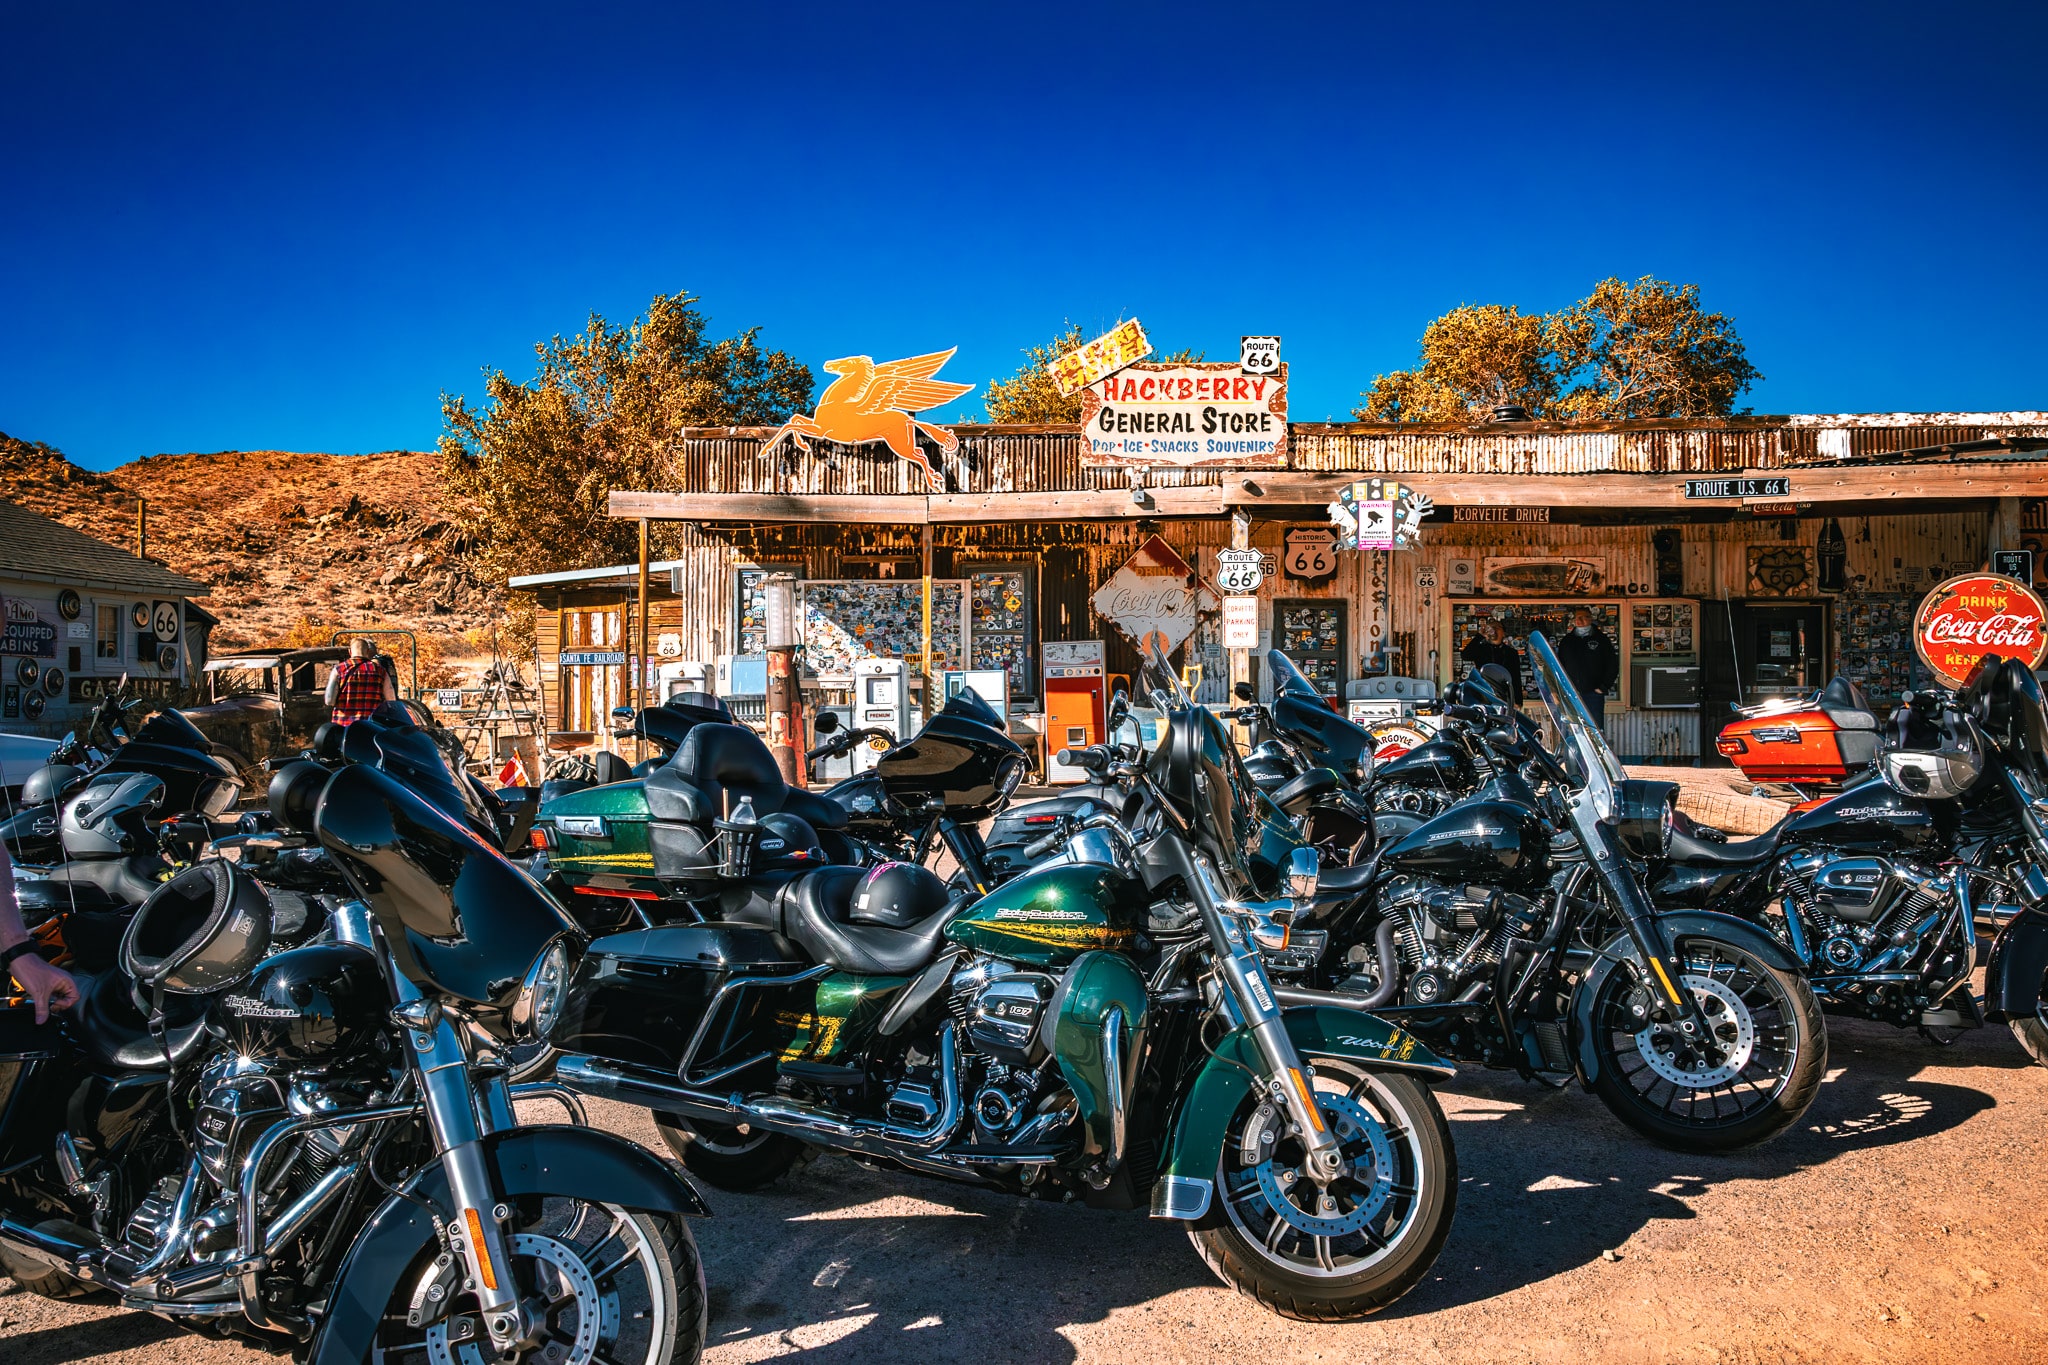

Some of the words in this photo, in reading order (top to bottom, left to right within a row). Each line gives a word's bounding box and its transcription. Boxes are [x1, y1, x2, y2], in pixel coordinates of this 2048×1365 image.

[1247, 343, 1274, 351] ROUTE
[1248, 353, 1273, 367] 66
[1103, 377, 1267, 400] HACKBERRY
[1099, 407, 1195, 434] GENERAL
[1202, 406, 1272, 434] STORE
[1151, 440, 1199, 453] SNACKS
[1207, 440, 1275, 453] SOUVENIRS
[1695, 482, 1730, 496] ROUTE
[1738, 481, 1759, 495] U.S.
[1765, 480, 1779, 494] 66
[1458, 507, 1509, 521] CORVETTE
[1516, 507, 1545, 521] DRIVE
[1295, 552, 1326, 571] 66
[1136, 567, 1175, 577] DRINK
[1260, 563, 1274, 575] 66
[1229, 573, 1252, 587] 66
[1419, 578, 1435, 587] 66
[1770, 570, 1794, 584] 66
[1111, 588, 1204, 619] Coca-Cola
[1960, 596, 2008, 607] DRINK
[156, 612, 175, 633] 66
[4, 625, 53, 640] EQUIPPED
[1925, 613, 2039, 646] Coca-Cola
[0, 640, 39, 652] ABINS
[663, 647, 674, 655] 66
[562, 654, 580, 663] SANTA
[583, 654, 591, 663] FE
[595, 653, 621, 663] RAILROAD
[81, 680, 171, 698] GASLINE
[7, 698, 16, 706] 66
[873, 740, 887, 748] 66
[1009, 1005, 1033, 1016] 107
[211, 1118, 226, 1130] 107
